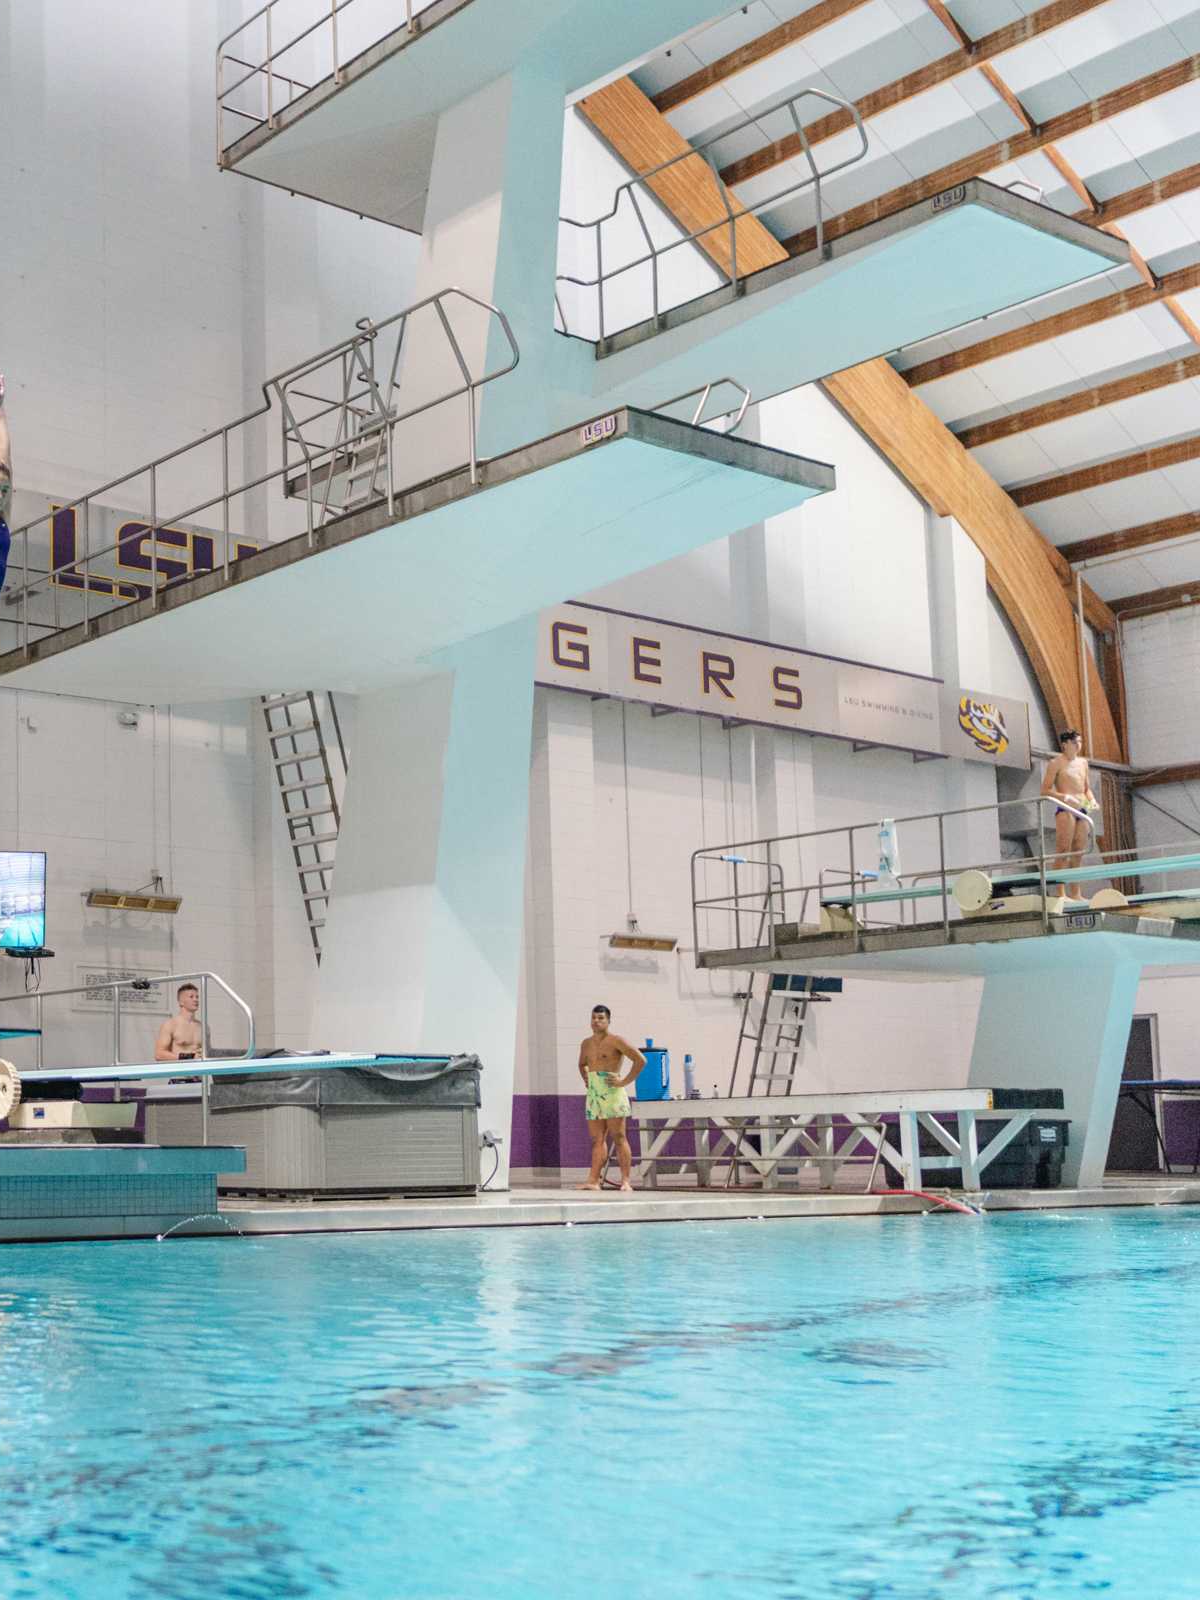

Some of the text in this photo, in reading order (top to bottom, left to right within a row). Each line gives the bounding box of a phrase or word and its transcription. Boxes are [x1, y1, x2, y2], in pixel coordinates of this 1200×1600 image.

[933, 186, 965, 209] LSU
[583, 417, 616, 443] LSU
[1065, 915, 1094, 928] LSU
